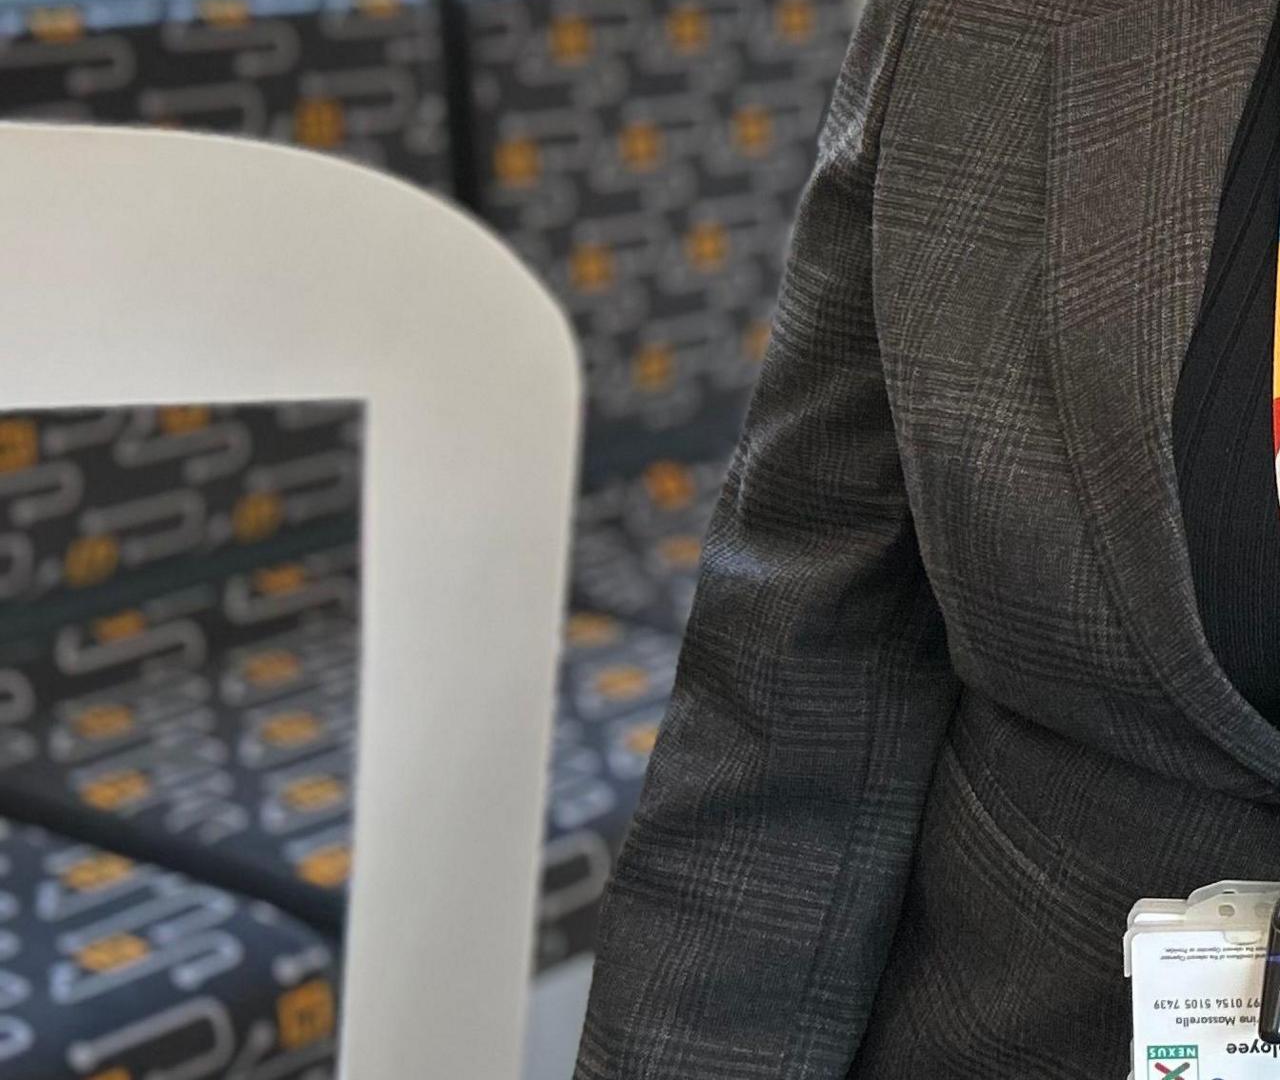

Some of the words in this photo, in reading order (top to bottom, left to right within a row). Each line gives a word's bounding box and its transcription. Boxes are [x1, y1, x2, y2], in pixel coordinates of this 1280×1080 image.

[1153, 999, 1180, 1010] 7439
[1185, 999, 1211, 1009] 5105
[1216, 999, 1243, 1009] 0154
[1175, 1016, 1236, 1028] Massarella
[1149, 1047, 1196, 1058] NEXUS
